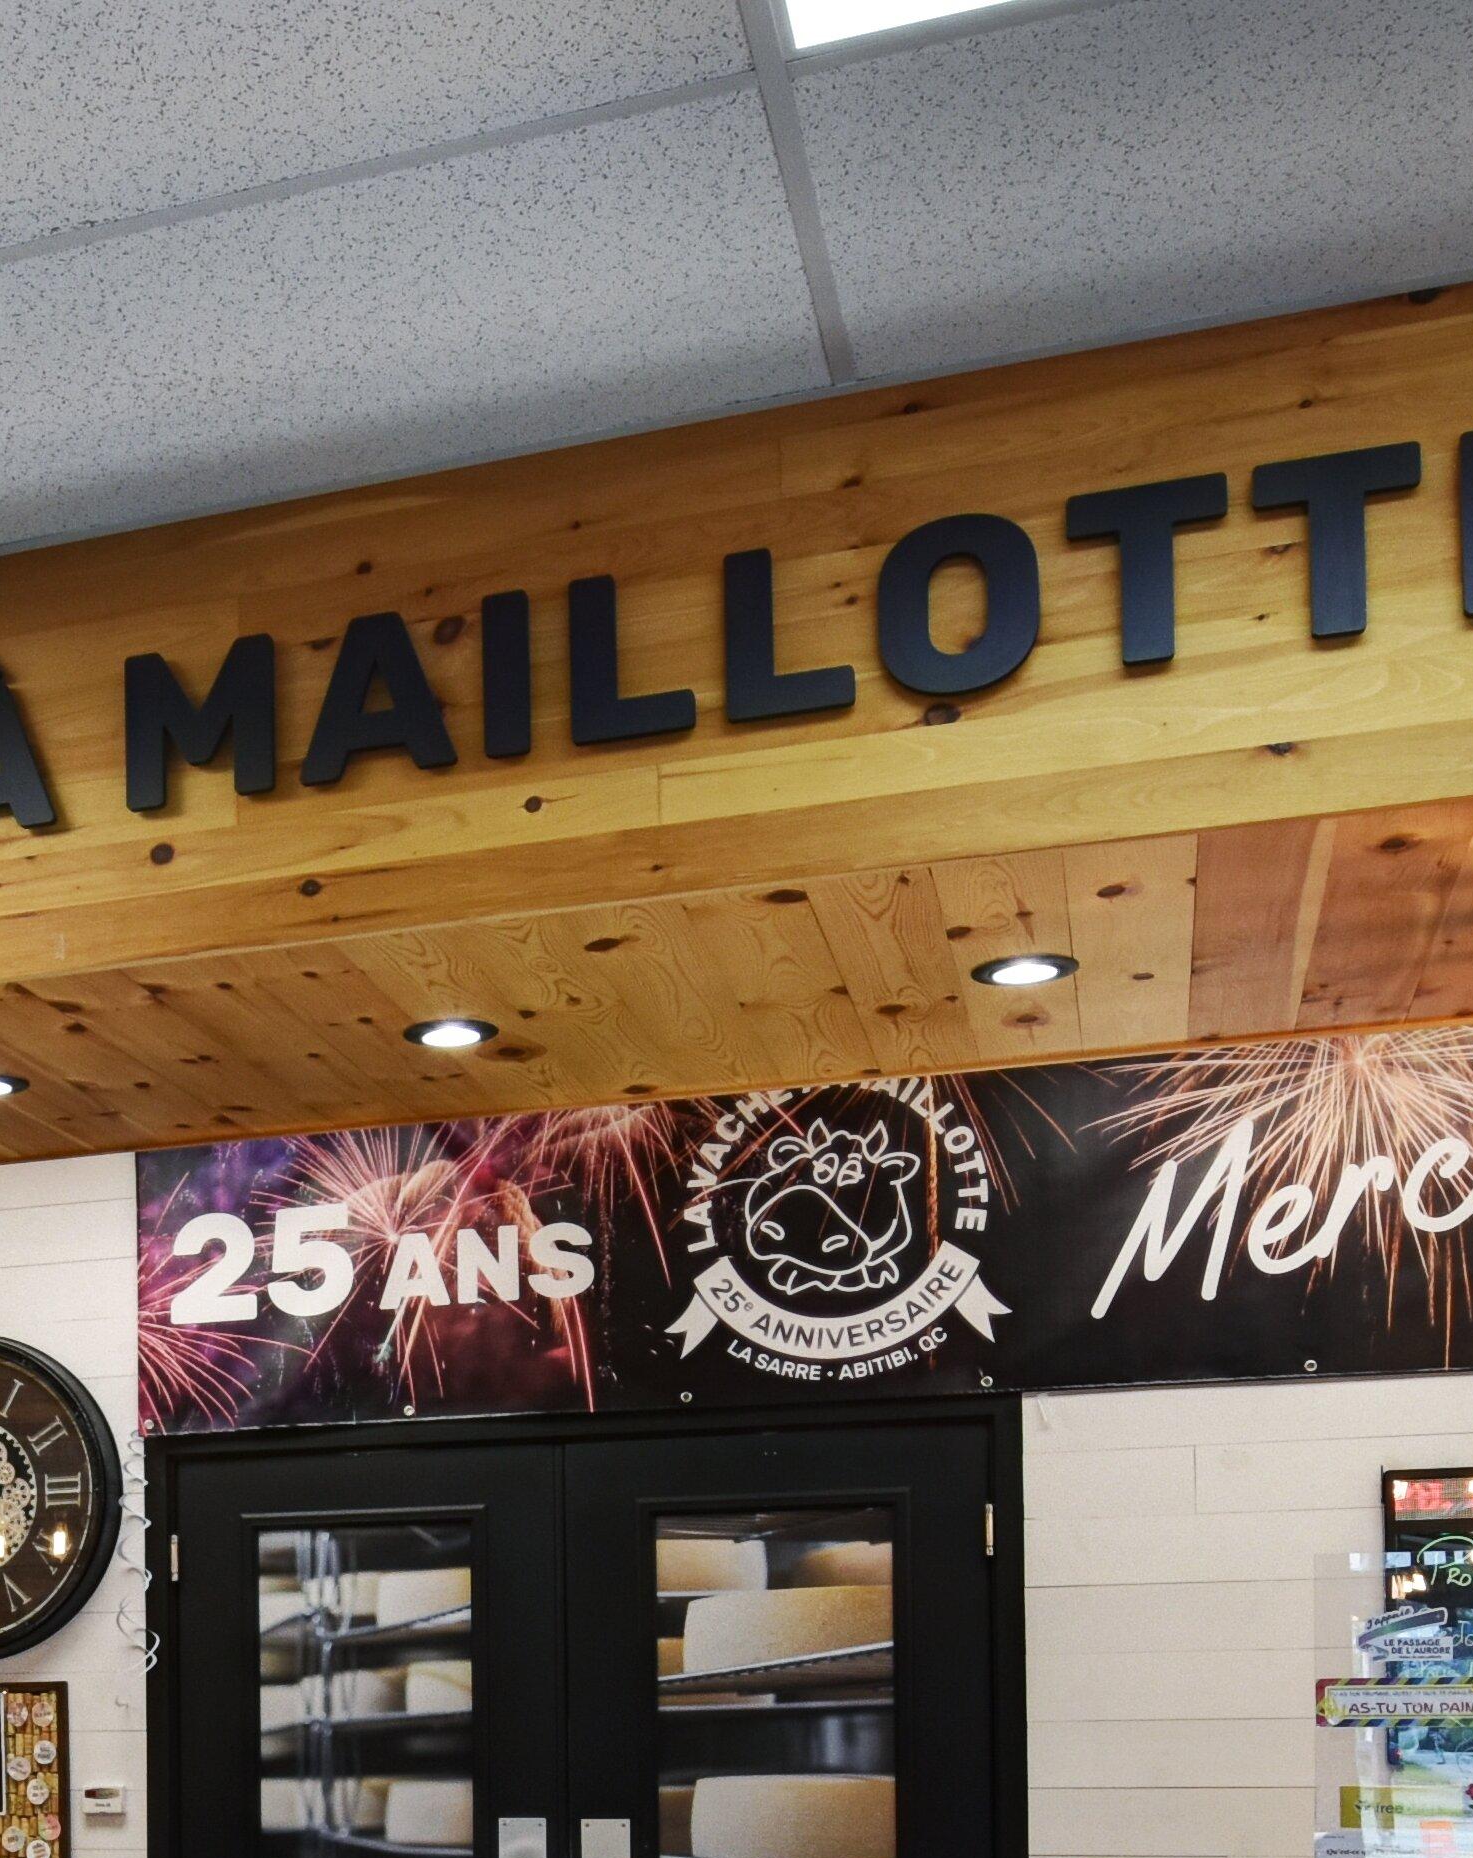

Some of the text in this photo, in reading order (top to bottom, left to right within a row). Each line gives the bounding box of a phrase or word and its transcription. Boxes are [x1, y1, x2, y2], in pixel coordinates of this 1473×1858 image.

[684, 1202, 719, 1253] LA
[170, 1203, 596, 1326] 25 ANS
[754, 1259, 965, 1350] ANNIVERSAIRE
[727, 1338, 752, 1365] LA
[753, 1352, 822, 1381] SARRE
[918, 1326, 948, 1355] QC
[1384, 1638, 1440, 1647] LE PASSAGE
[1391, 1646, 1452, 1655] DE L'AURORE
[1349, 1703, 1398, 1714] AS-TU
[1402, 1702, 1432, 1714] TON
